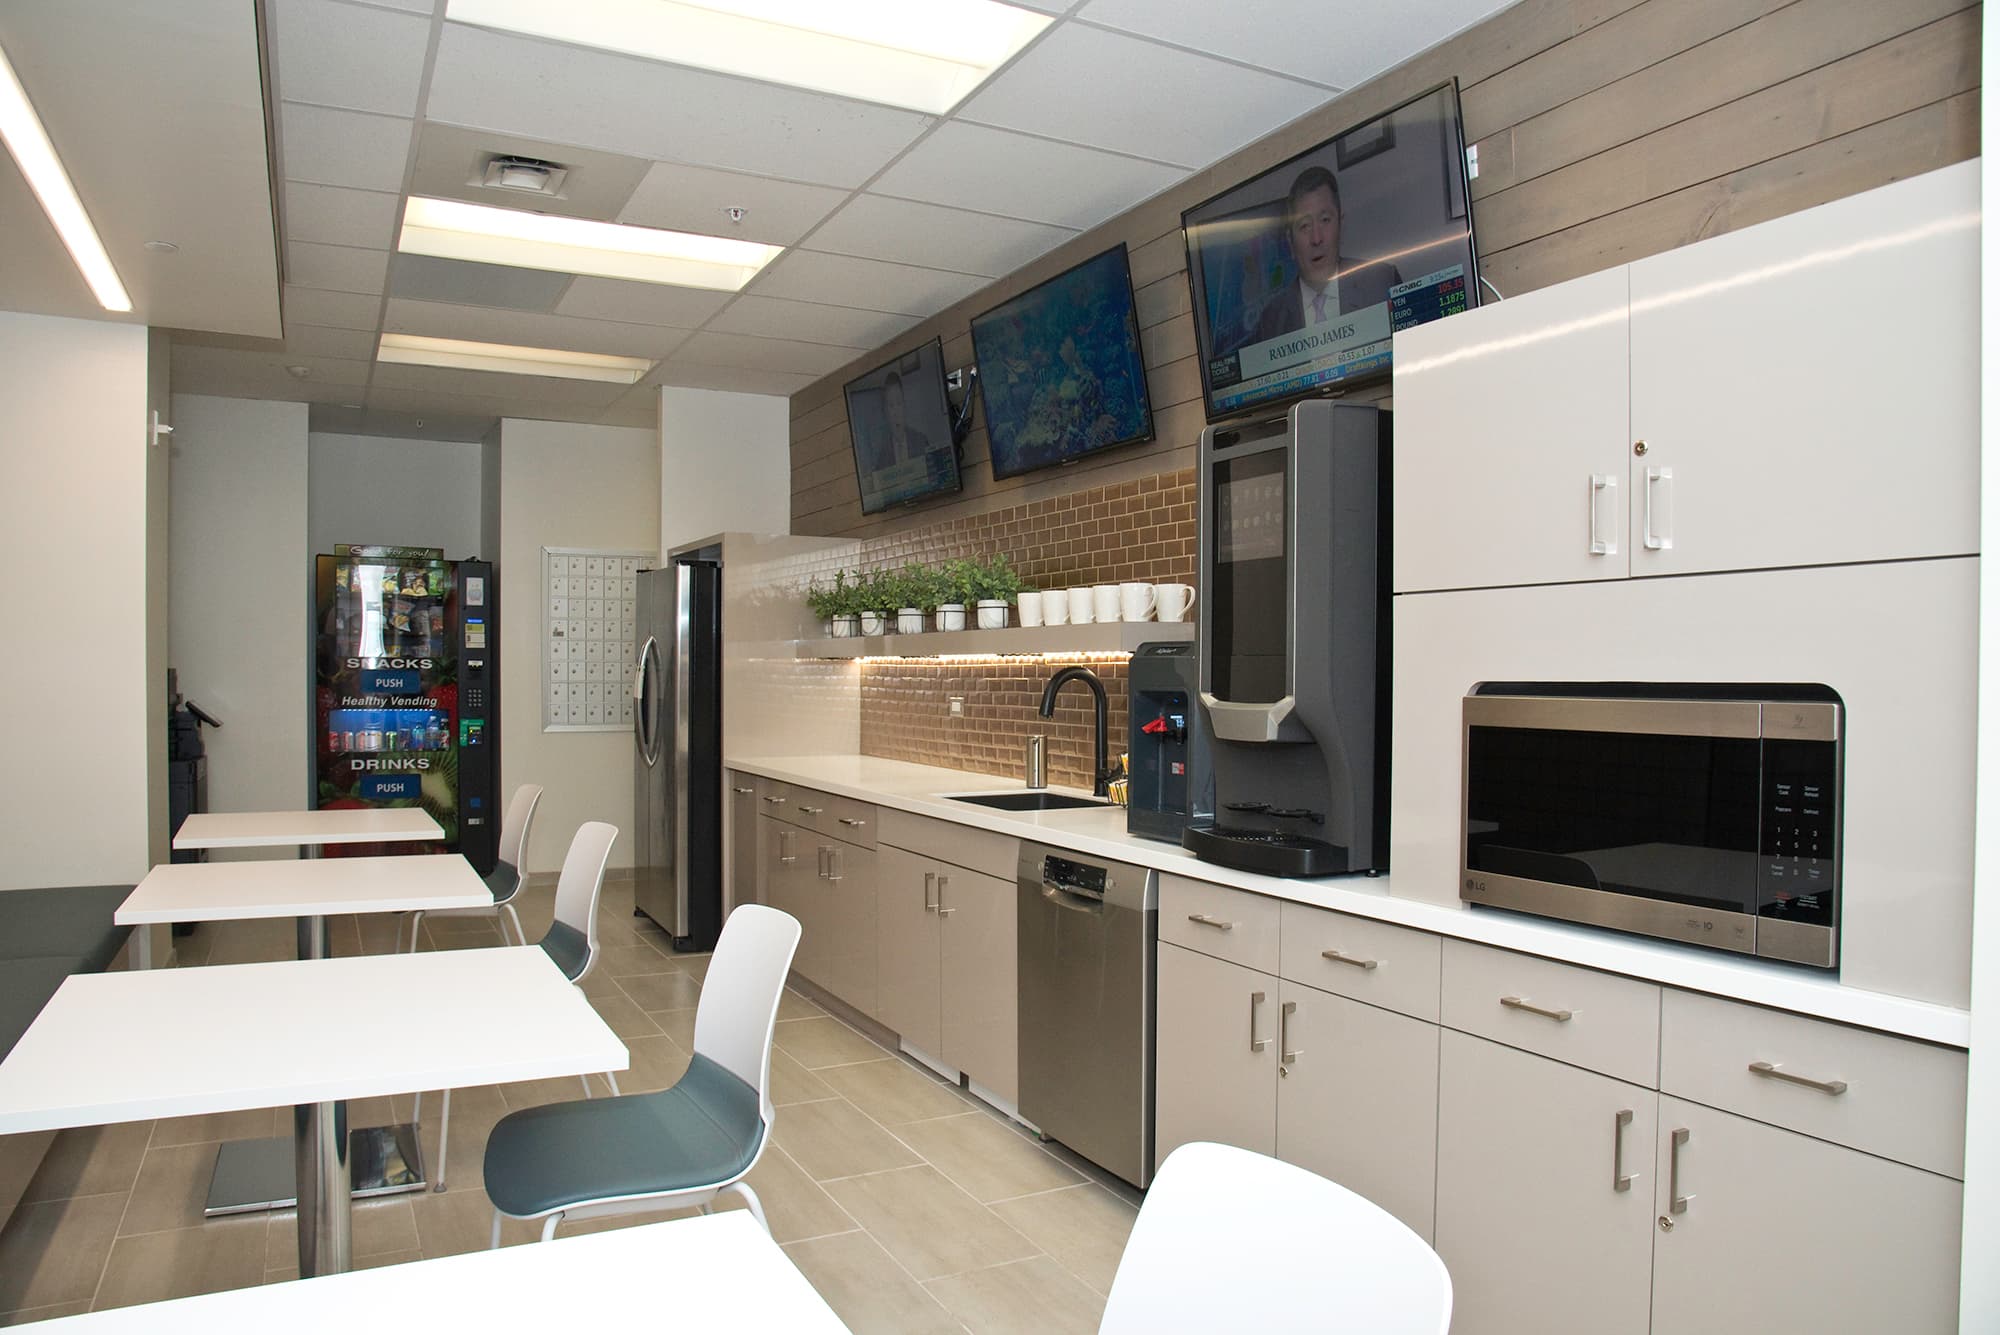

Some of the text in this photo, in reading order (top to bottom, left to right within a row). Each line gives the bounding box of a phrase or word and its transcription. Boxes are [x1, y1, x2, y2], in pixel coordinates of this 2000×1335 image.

[1399, 280, 1422, 293] CNBC
[1393, 297, 1406, 307] YEN
[1394, 308, 1412, 320] EURO
[1269, 324, 1355, 360] RAYMOND JAMES
[346, 658, 433, 669] SNACKS
[375, 679, 403, 688] PUSH
[342, 696, 438, 708] Healthy Vending
[351, 759, 430, 770] DRINKS
[377, 783, 404, 792] PUSH
